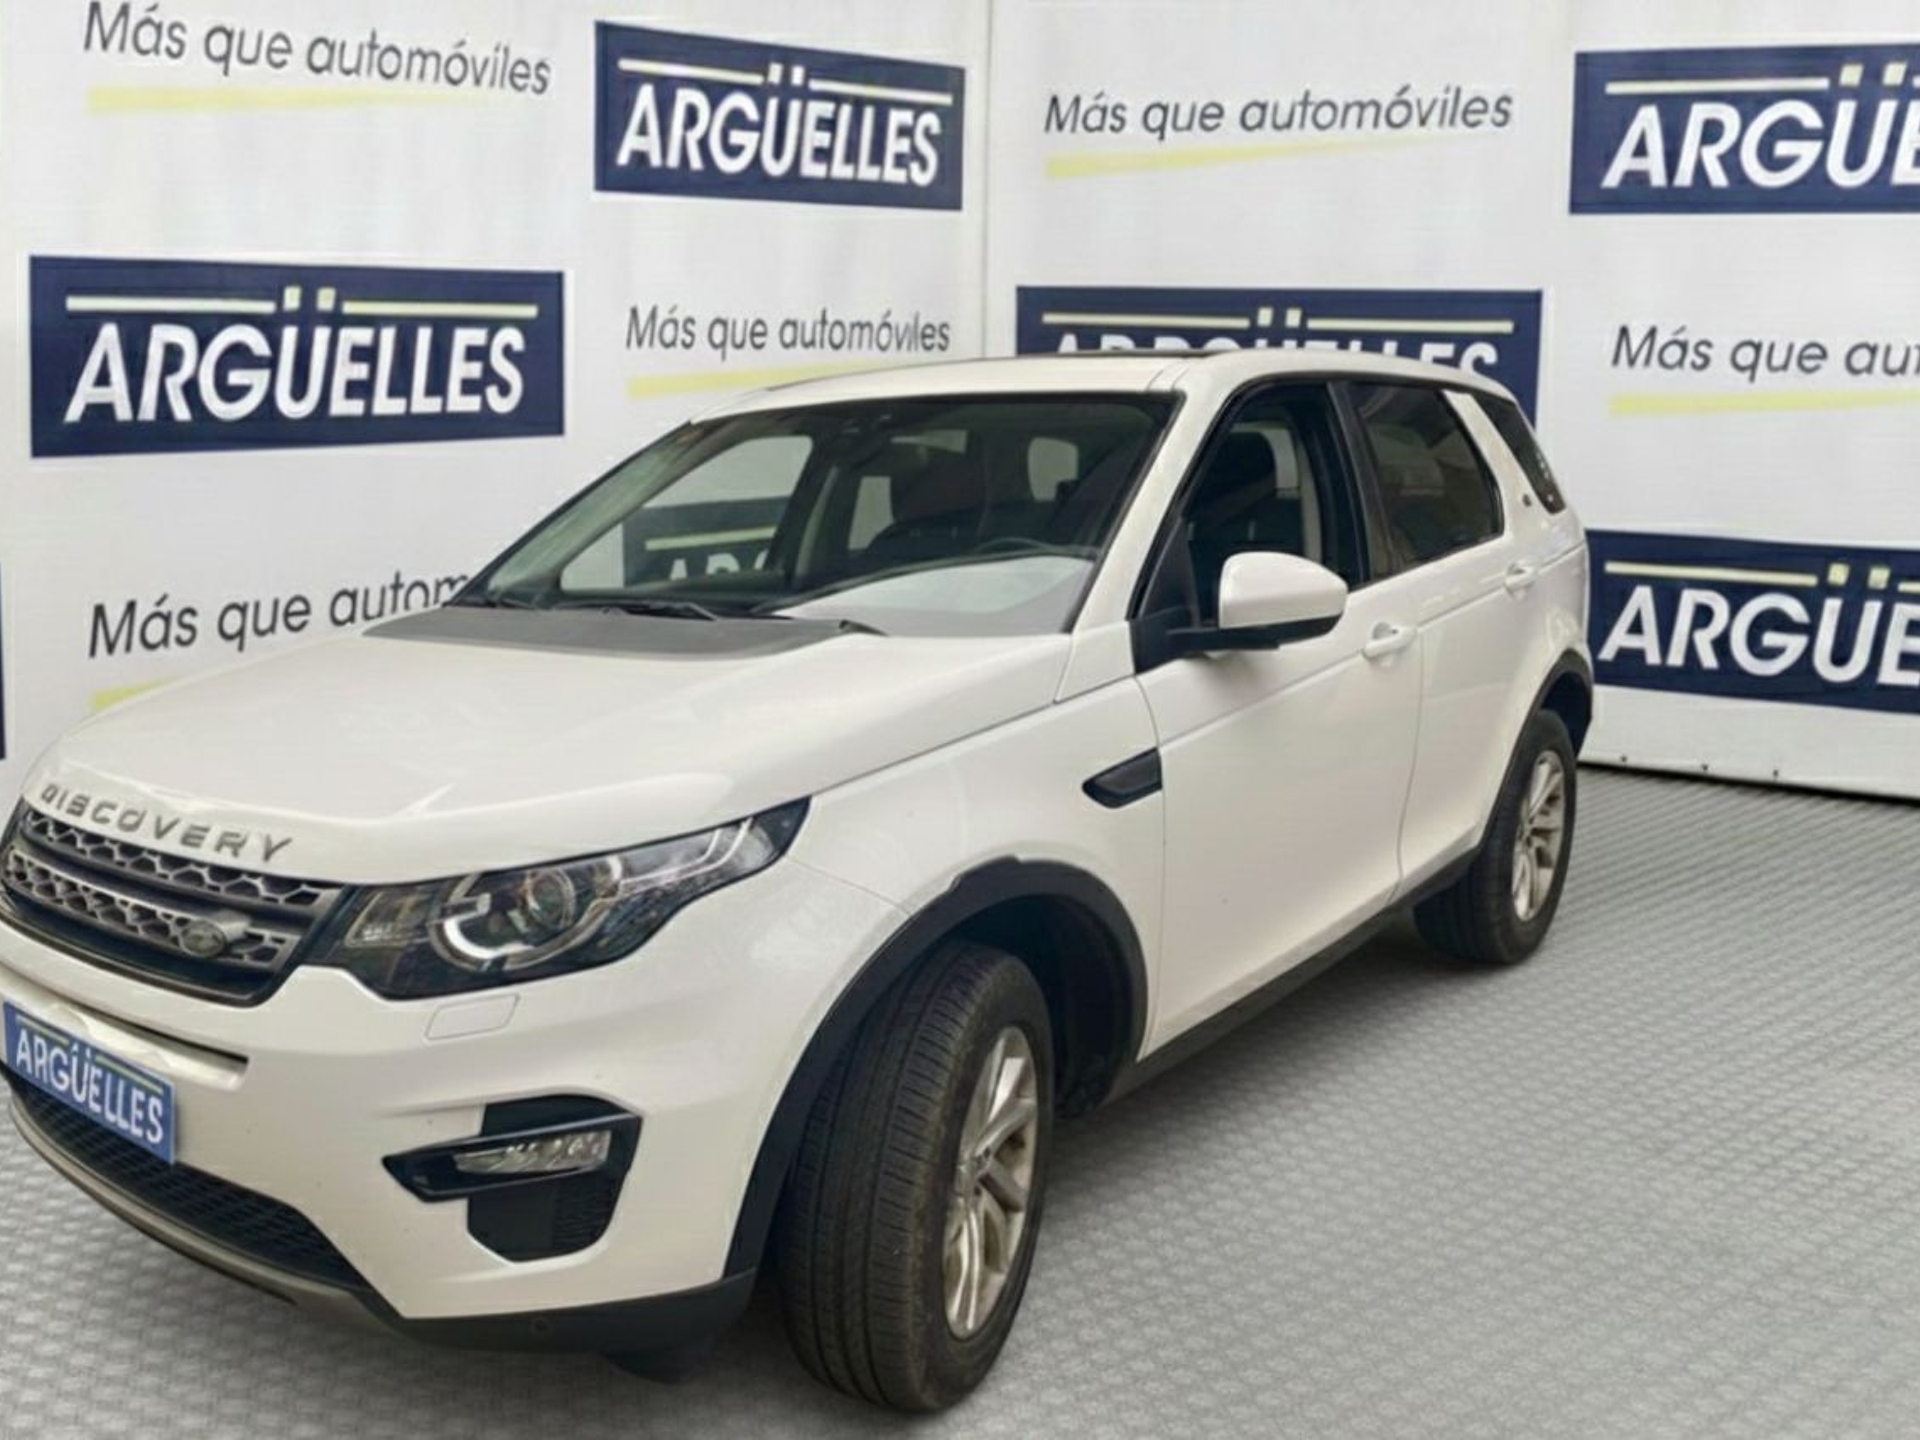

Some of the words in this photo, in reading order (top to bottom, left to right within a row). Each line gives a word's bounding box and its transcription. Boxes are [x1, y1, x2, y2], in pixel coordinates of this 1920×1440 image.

[83, 0, 186, 59] Más
[203, 22, 293, 76] que
[306, 29, 550, 95] automóviles
[616, 62, 942, 188] ARGÜELLES
[1043, 91, 1127, 134] Más
[1142, 100, 1223, 142] que
[1239, 83, 1513, 131] automóviles
[63, 285, 527, 425] ARGÜELLES
[625, 304, 696, 351] Más
[707, 317, 769, 362] que
[778, 307, 951, 354] automóviles
[1610, 324, 1712, 371] Más
[1730, 336, 1828, 382] que
[88, 592, 198, 659] Más
[217, 594, 312, 653] que
[40, 783, 293, 864] DISCOVERY
[15, 1028, 164, 1145] ARGÜELLES
